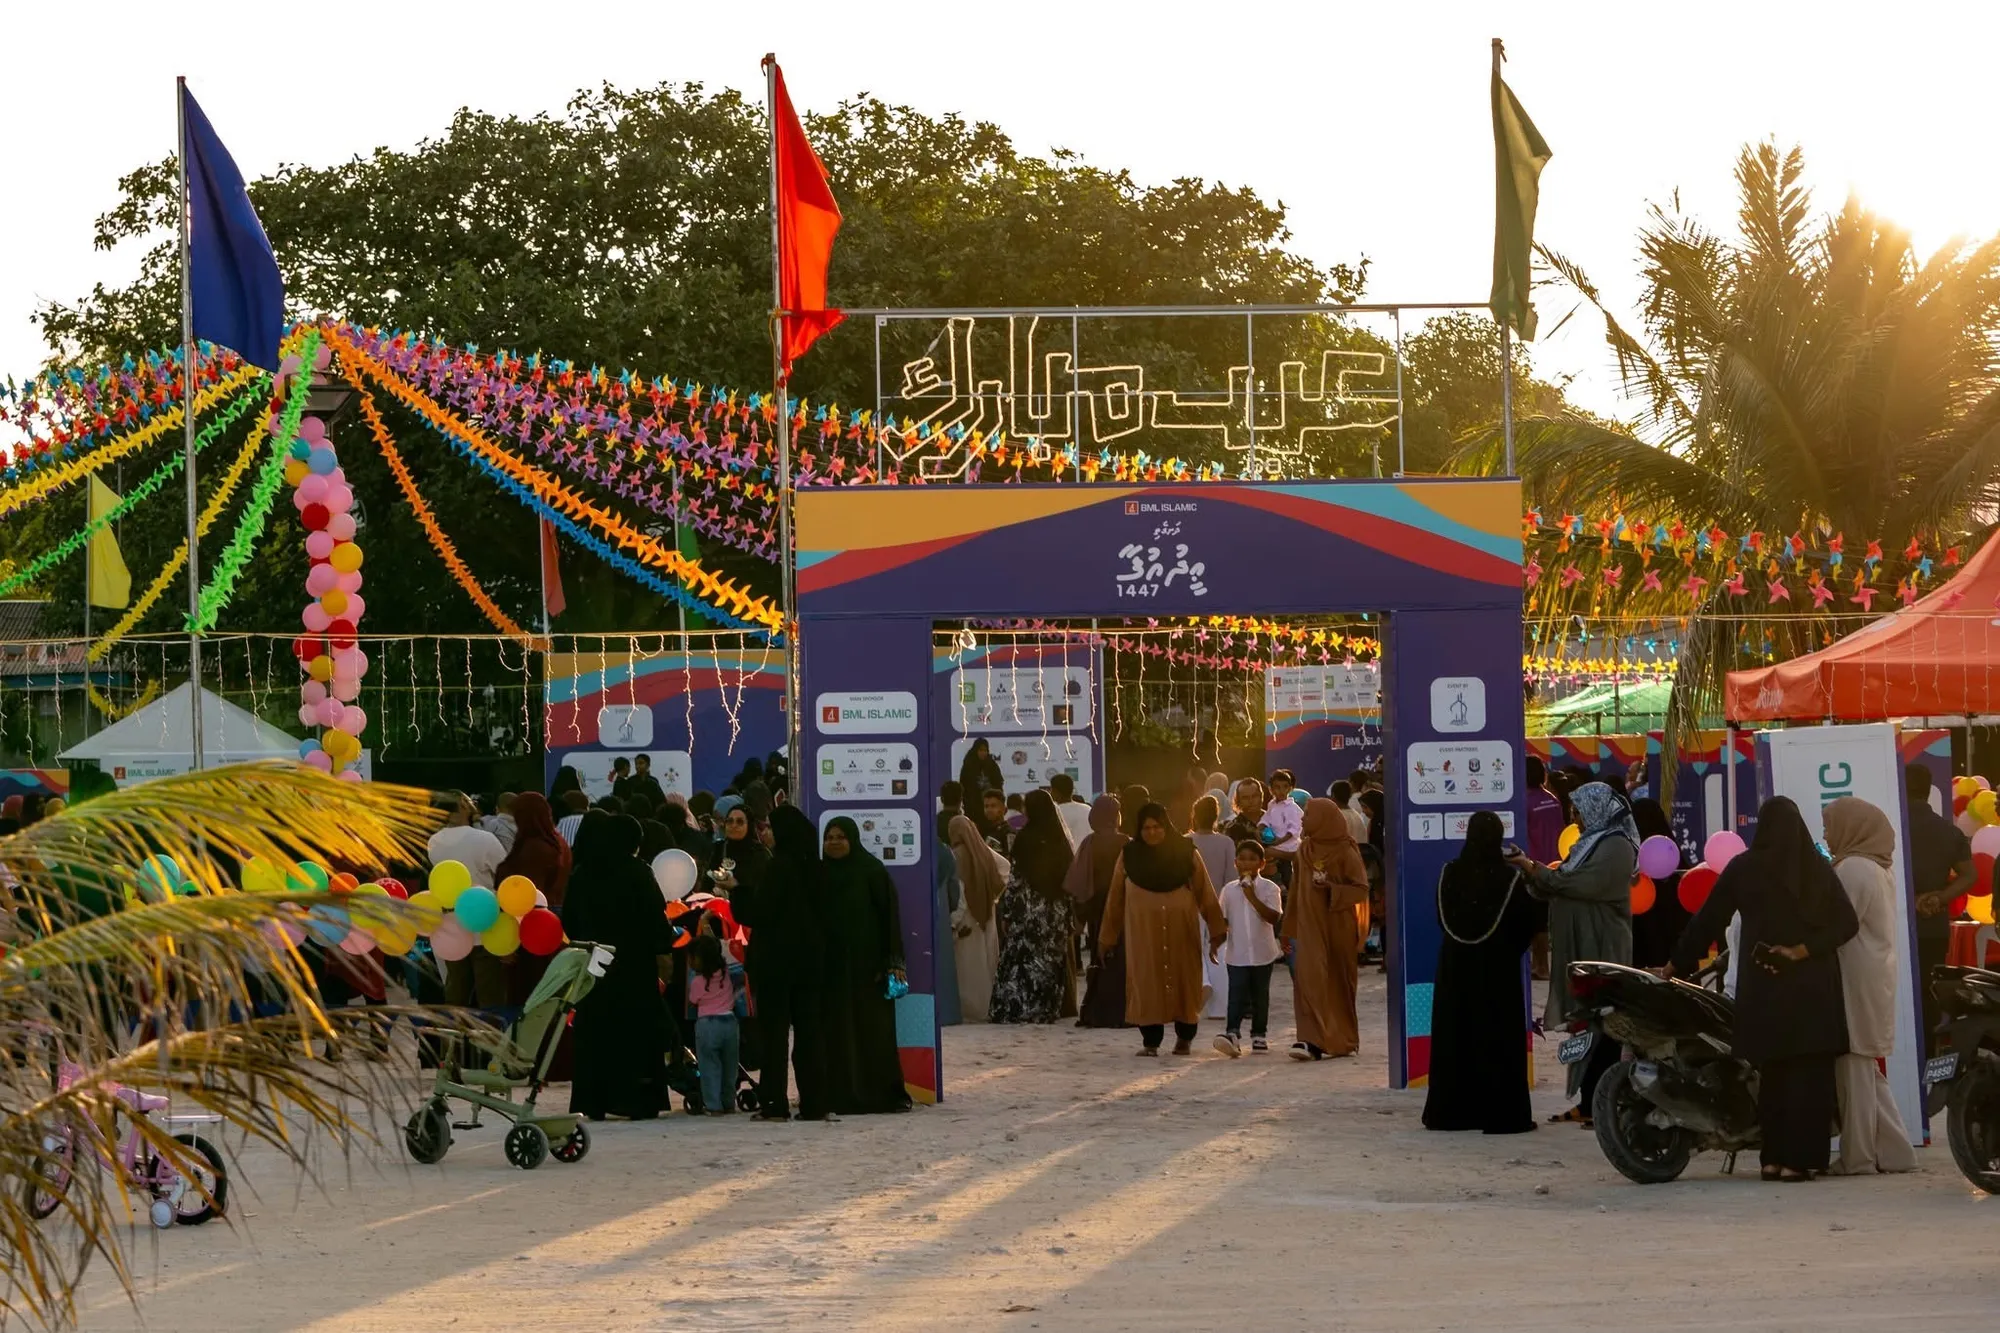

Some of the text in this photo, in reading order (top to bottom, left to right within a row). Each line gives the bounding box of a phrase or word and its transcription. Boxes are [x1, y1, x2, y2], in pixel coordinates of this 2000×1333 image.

[1140, 503, 1198, 512] BML ISLAMIC
[1116, 584, 1159, 597] 1447
[842, 708, 912, 719] BML ISLAMIC
[1345, 736, 1383, 746] BML ISLA
